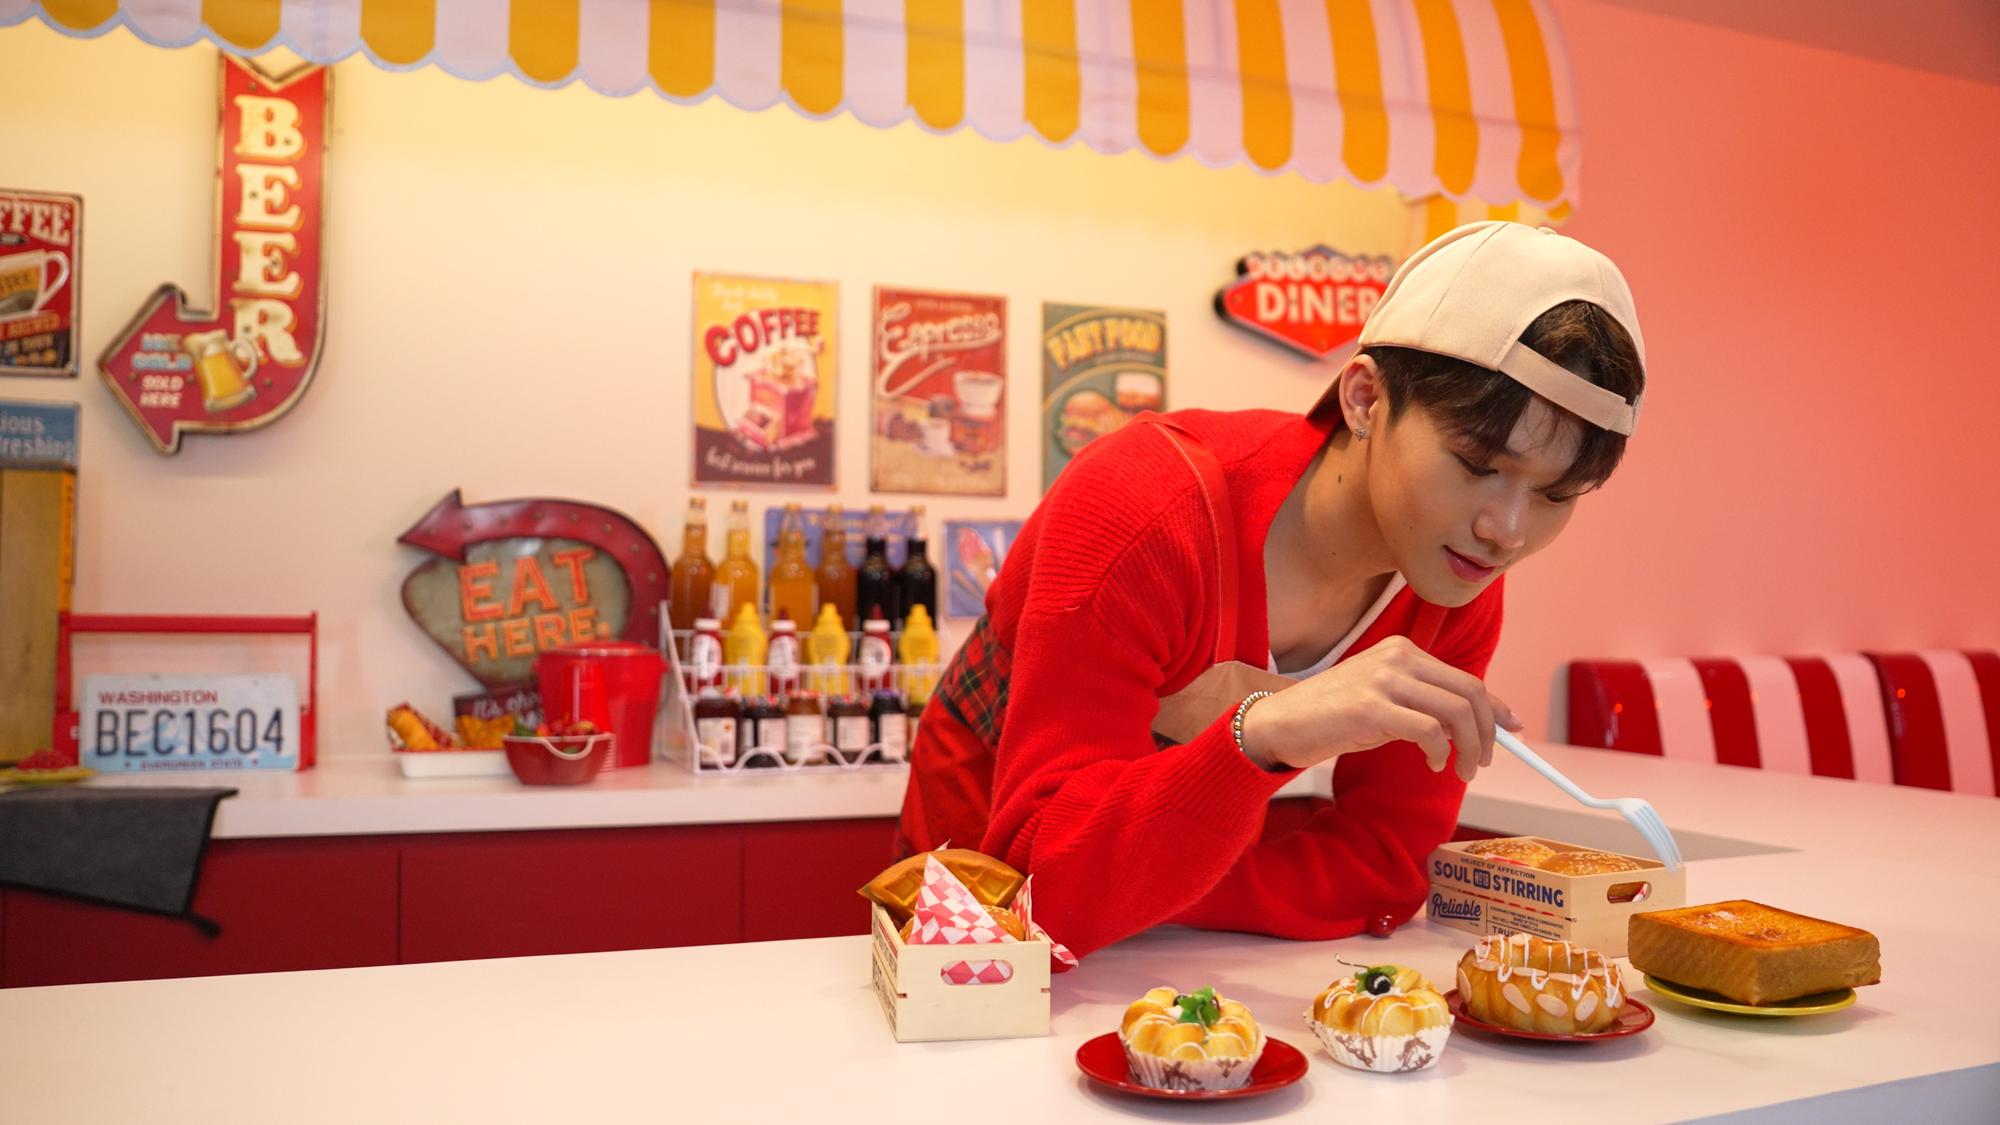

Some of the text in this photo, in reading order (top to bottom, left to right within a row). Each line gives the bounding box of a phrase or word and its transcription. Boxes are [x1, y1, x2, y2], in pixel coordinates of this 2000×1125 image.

[232, 94, 305, 367] BEER
[705, 307, 821, 367] COFFEE
[1047, 318, 1162, 371] FAST FOOD
[458, 551, 596, 622] EAT
[98, 690, 218, 706] WASHINGTON
[96, 707, 285, 758] BEC1604
[1434, 860, 1471, 884] SOUL
[1492, 873, 1565, 908] STIRRING
[1460, 856, 1485, 868] OBJECT
[1497, 865, 1536, 880] AFFECTION
[1431, 892, 1482, 918] Reliable
